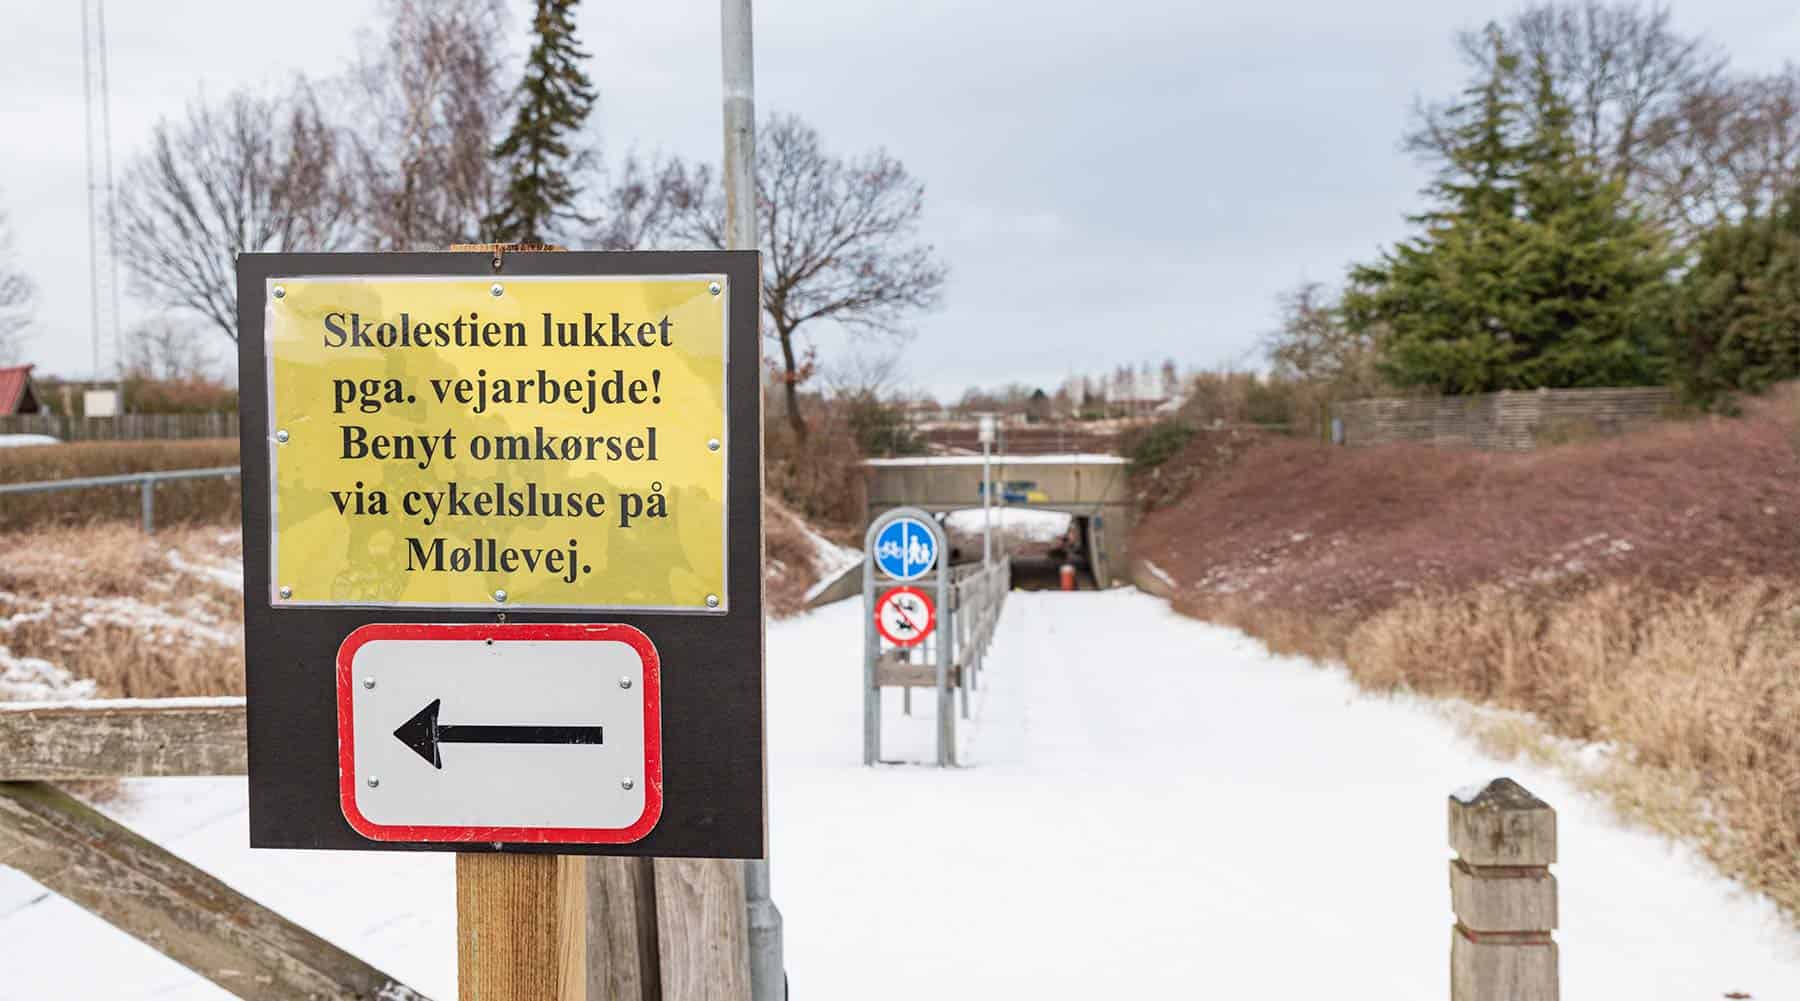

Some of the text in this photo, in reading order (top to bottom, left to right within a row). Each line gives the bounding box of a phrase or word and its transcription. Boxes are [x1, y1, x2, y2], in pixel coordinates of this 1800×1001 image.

[322, 312, 673, 348] Skolestien lukket
[333, 369, 661, 414] pga. vejarbejde!
[340, 425, 658, 470] Benyt omkørsel
[329, 481, 668, 528] via cykelsluse på
[405, 537, 592, 584] Møllevej.
